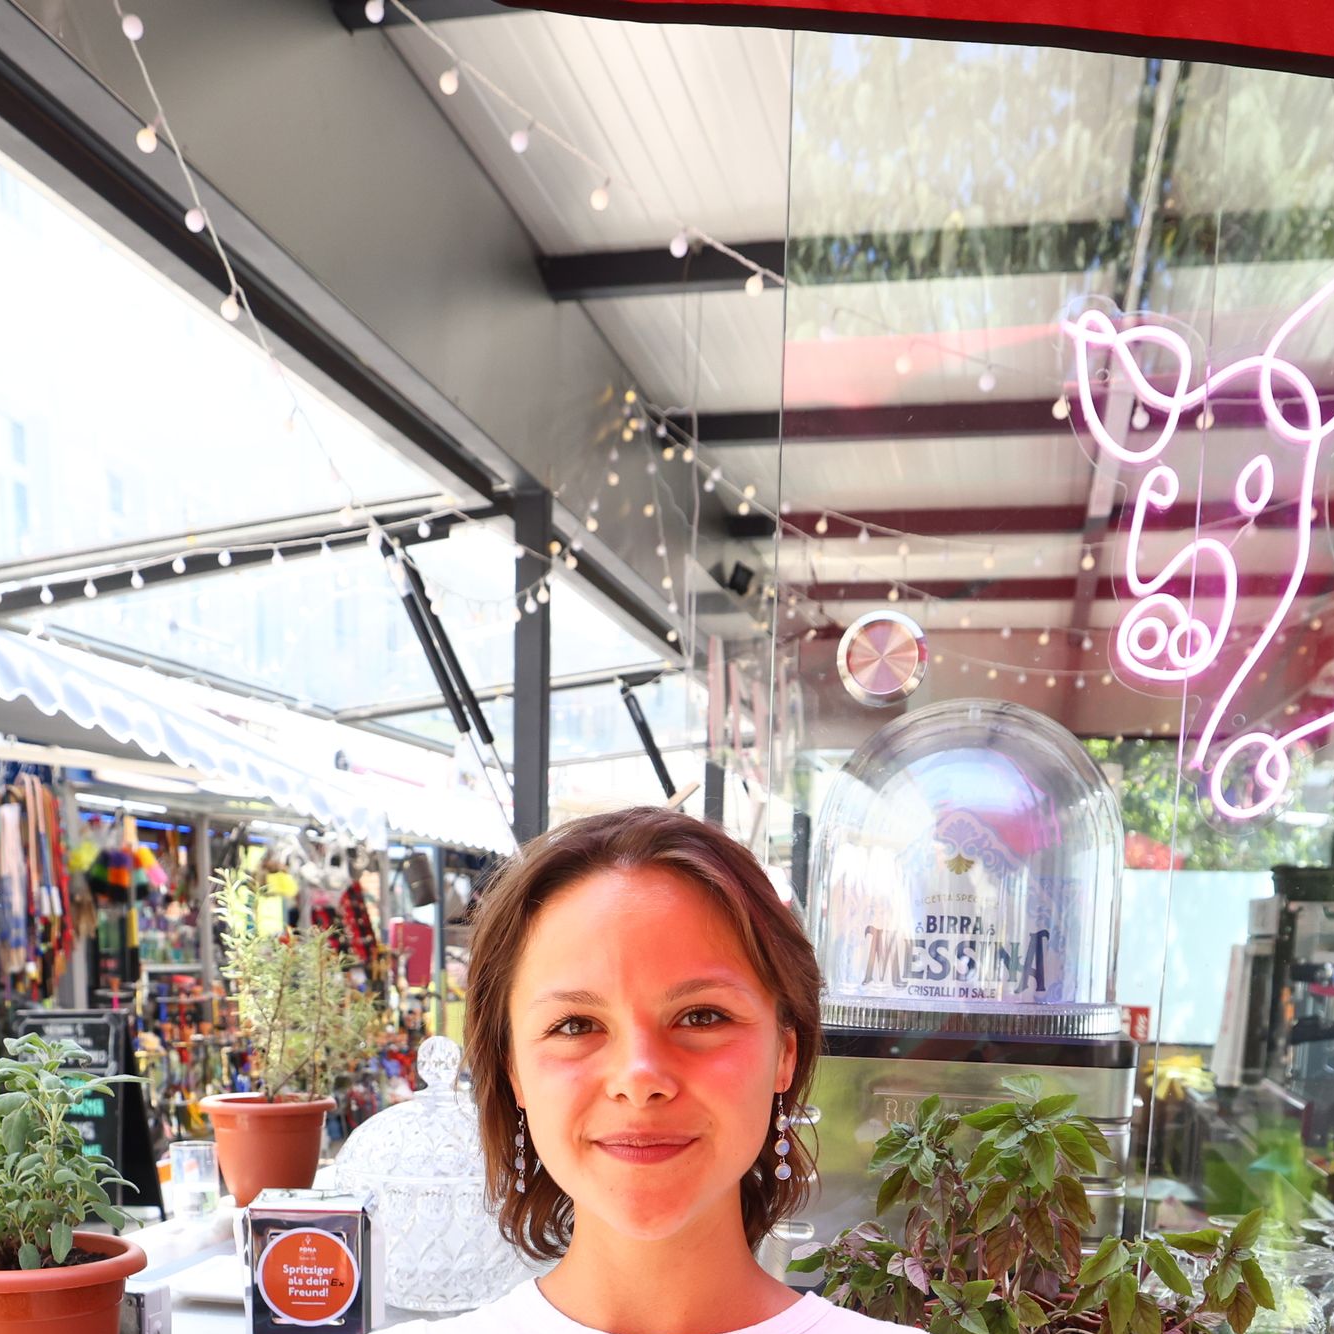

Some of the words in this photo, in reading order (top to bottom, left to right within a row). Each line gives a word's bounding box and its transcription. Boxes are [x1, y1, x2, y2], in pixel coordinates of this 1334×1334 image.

[926, 915, 983, 935] BIRRA
[862, 924, 1050, 994] MESSINA
[907, 984, 956, 998] CRISTALLI
[959, 987, 969, 998] DI
[282, 1263, 335, 1277] Spritziger
[288, 1276, 304, 1286] als
[306, 1276, 329, 1286] dein
[288, 1287, 329, 1297] Freund!
